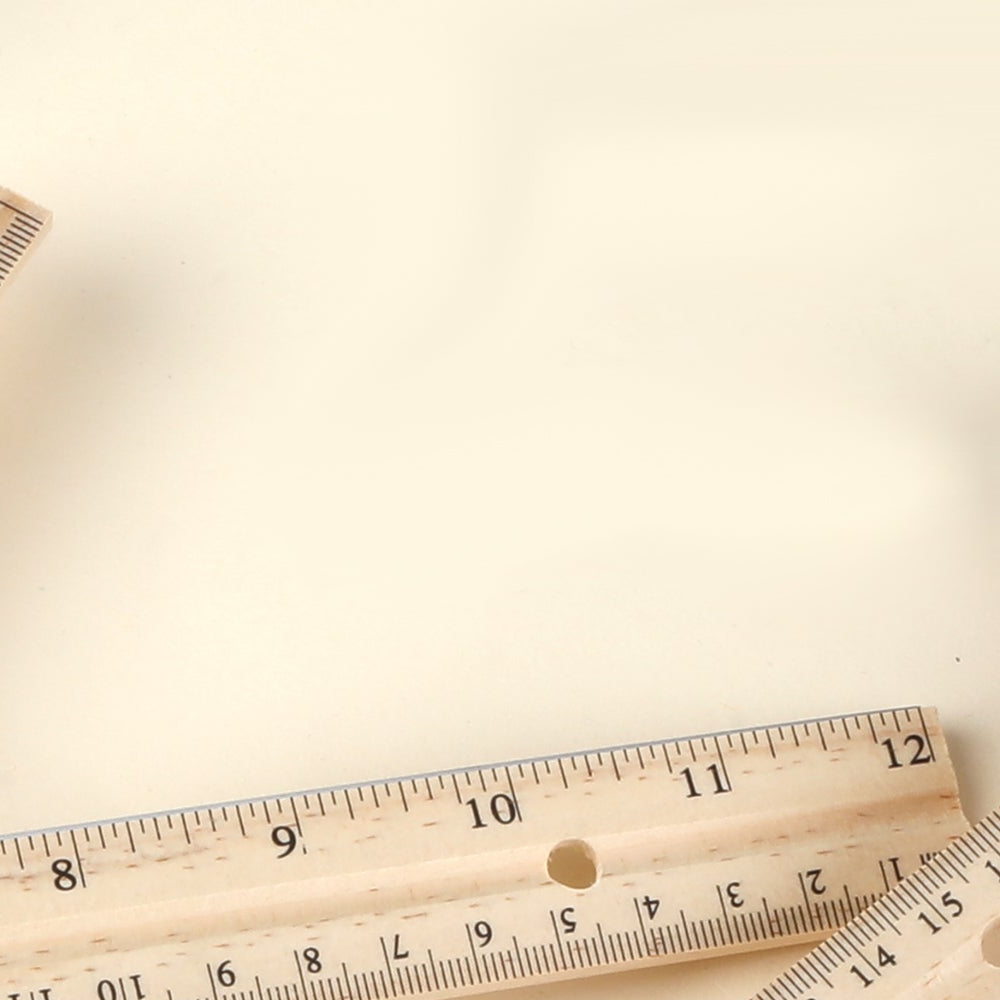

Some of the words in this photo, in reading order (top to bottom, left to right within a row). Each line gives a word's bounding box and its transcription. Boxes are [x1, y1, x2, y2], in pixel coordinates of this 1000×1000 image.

[51, 859, 77, 891] 8
[272, 826, 297, 858] 9
[466, 793, 516, 829] 10
[684, 764, 729, 798] 11
[881, 734, 931, 769] 12
[806, 869, 826, 895] 2
[888, 857, 904, 882] 1
[727, 882, 744, 907] 3
[560, 908, 577, 933] 5
[643, 896, 660, 920] 4
[394, 934, 409, 960] 7
[474, 920, 493, 948] 6
[850, 945, 897, 988] 14
[917, 891, 964, 935] 15
[303, 947, 322, 973] 8
[217, 960, 236, 987] 9
